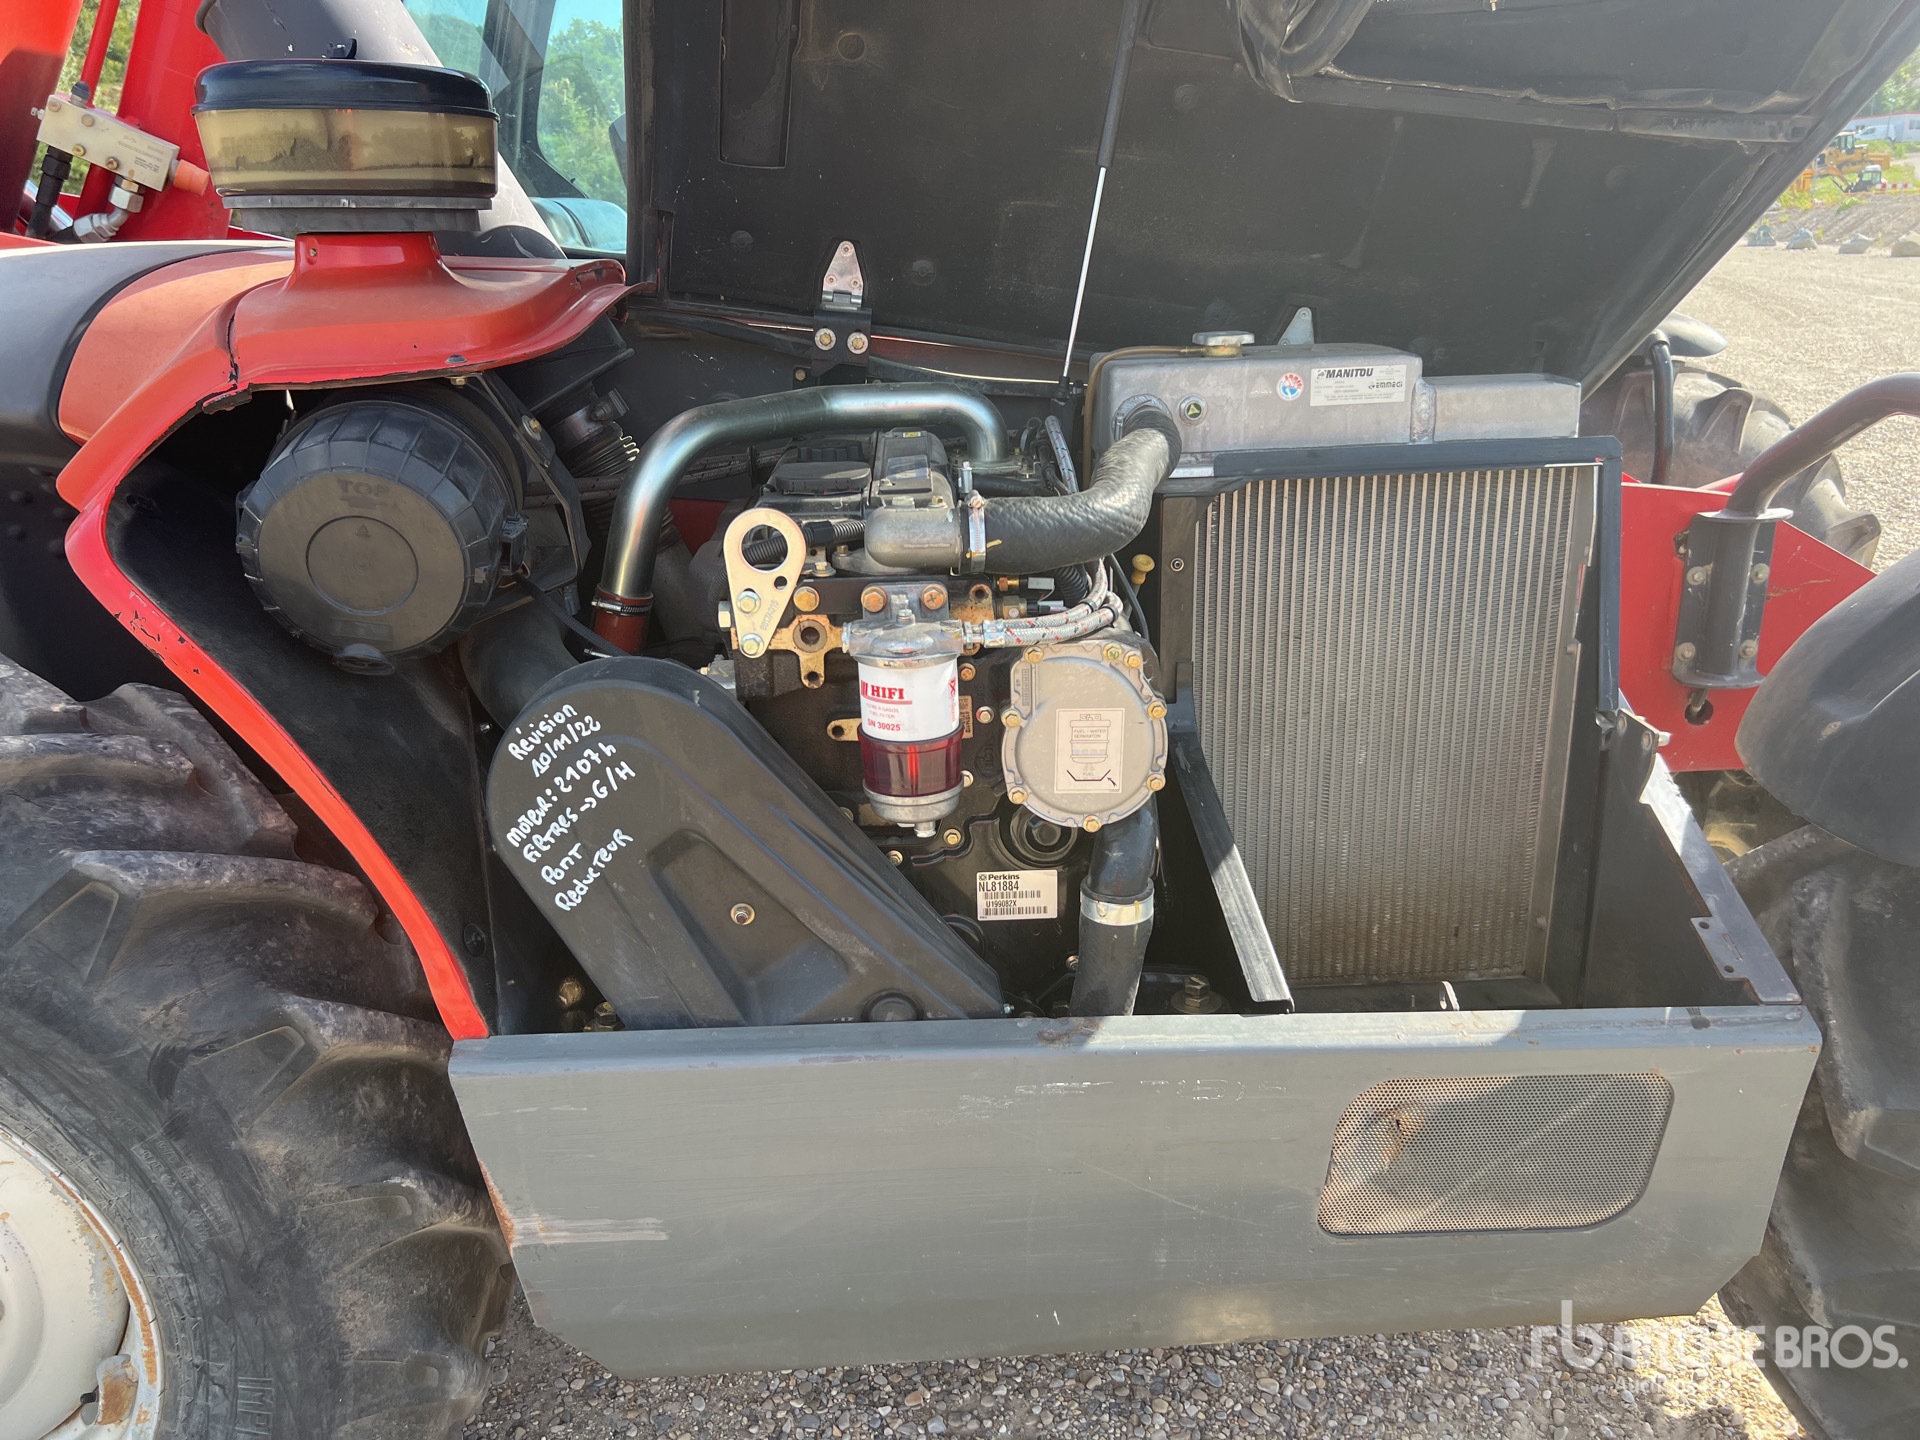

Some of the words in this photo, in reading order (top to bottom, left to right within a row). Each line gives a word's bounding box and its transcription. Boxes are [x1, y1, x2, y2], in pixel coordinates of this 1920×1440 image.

[1326, 368, 1374, 378] MANITOU
[871, 685, 904, 700] HIFI
[867, 718, 876, 727] SN
[877, 721, 901, 731] 30025
[531, 715, 601, 778] 10/11/22
[553, 748, 601, 793] 2107
[988, 873, 1020, 881] Perkins
[978, 881, 1020, 892] NL81884
